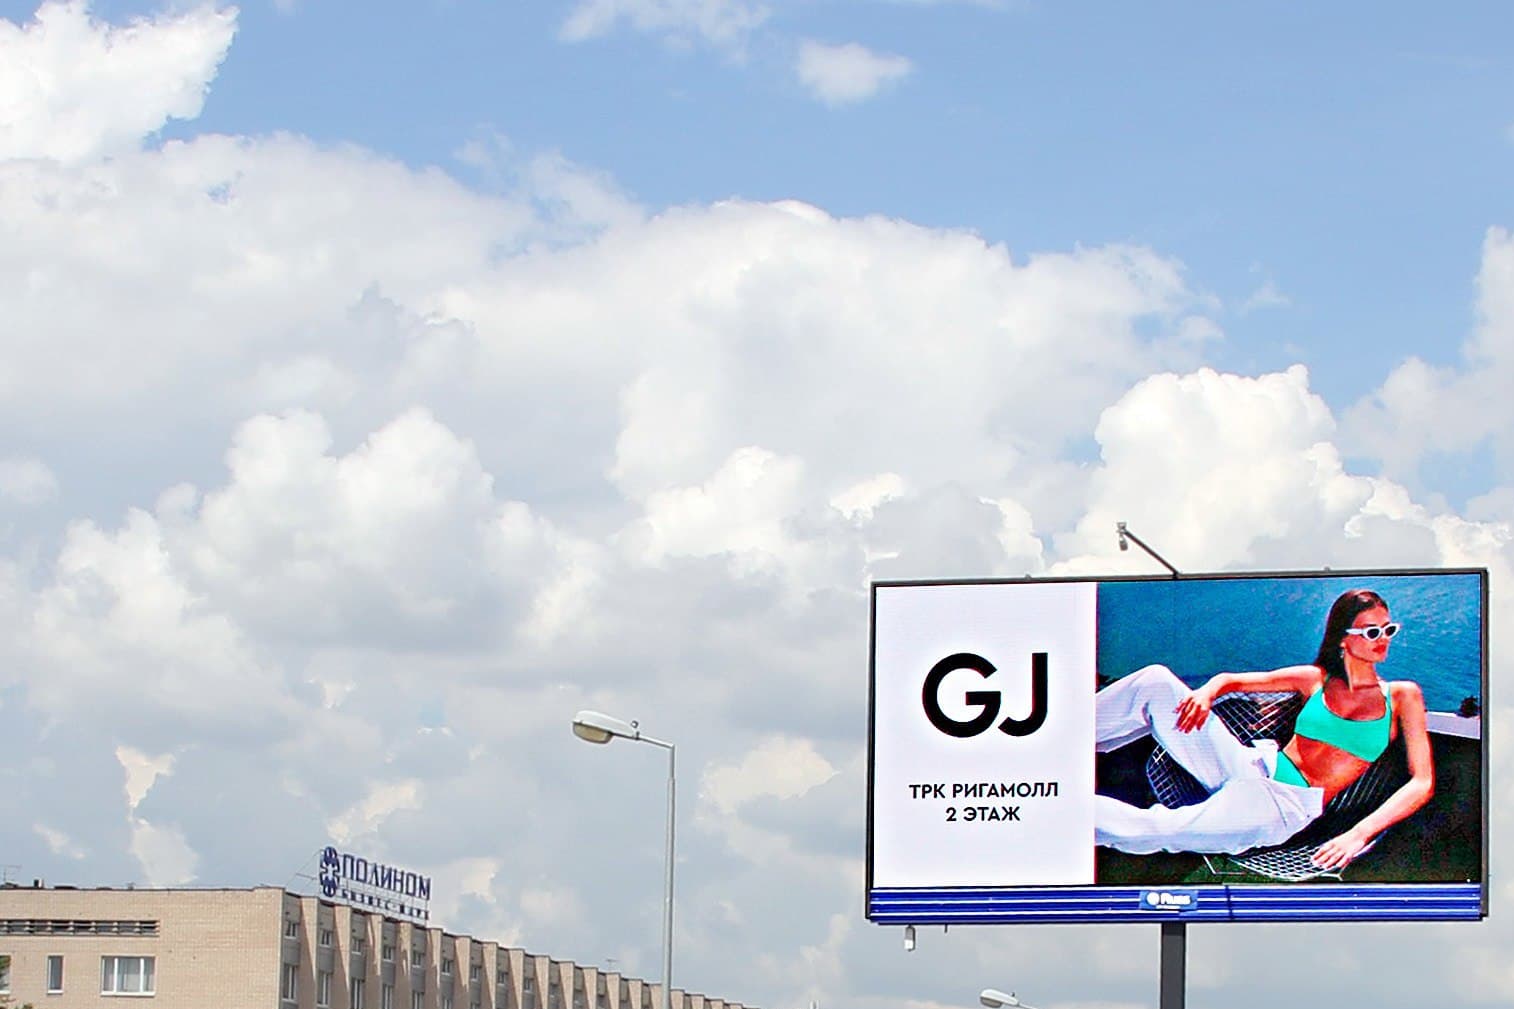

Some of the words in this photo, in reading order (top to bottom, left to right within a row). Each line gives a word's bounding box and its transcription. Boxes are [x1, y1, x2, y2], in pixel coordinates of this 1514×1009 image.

[922, 652, 1049, 738] GJ
[909, 783, 946, 799] ТРК
[952, 782, 1059, 798] РИГАМОЛЛ
[945, 806, 957, 822] 2
[963, 806, 1021, 822] ЭТАЖ
[342, 853, 431, 901] ПОЛИНОМ
